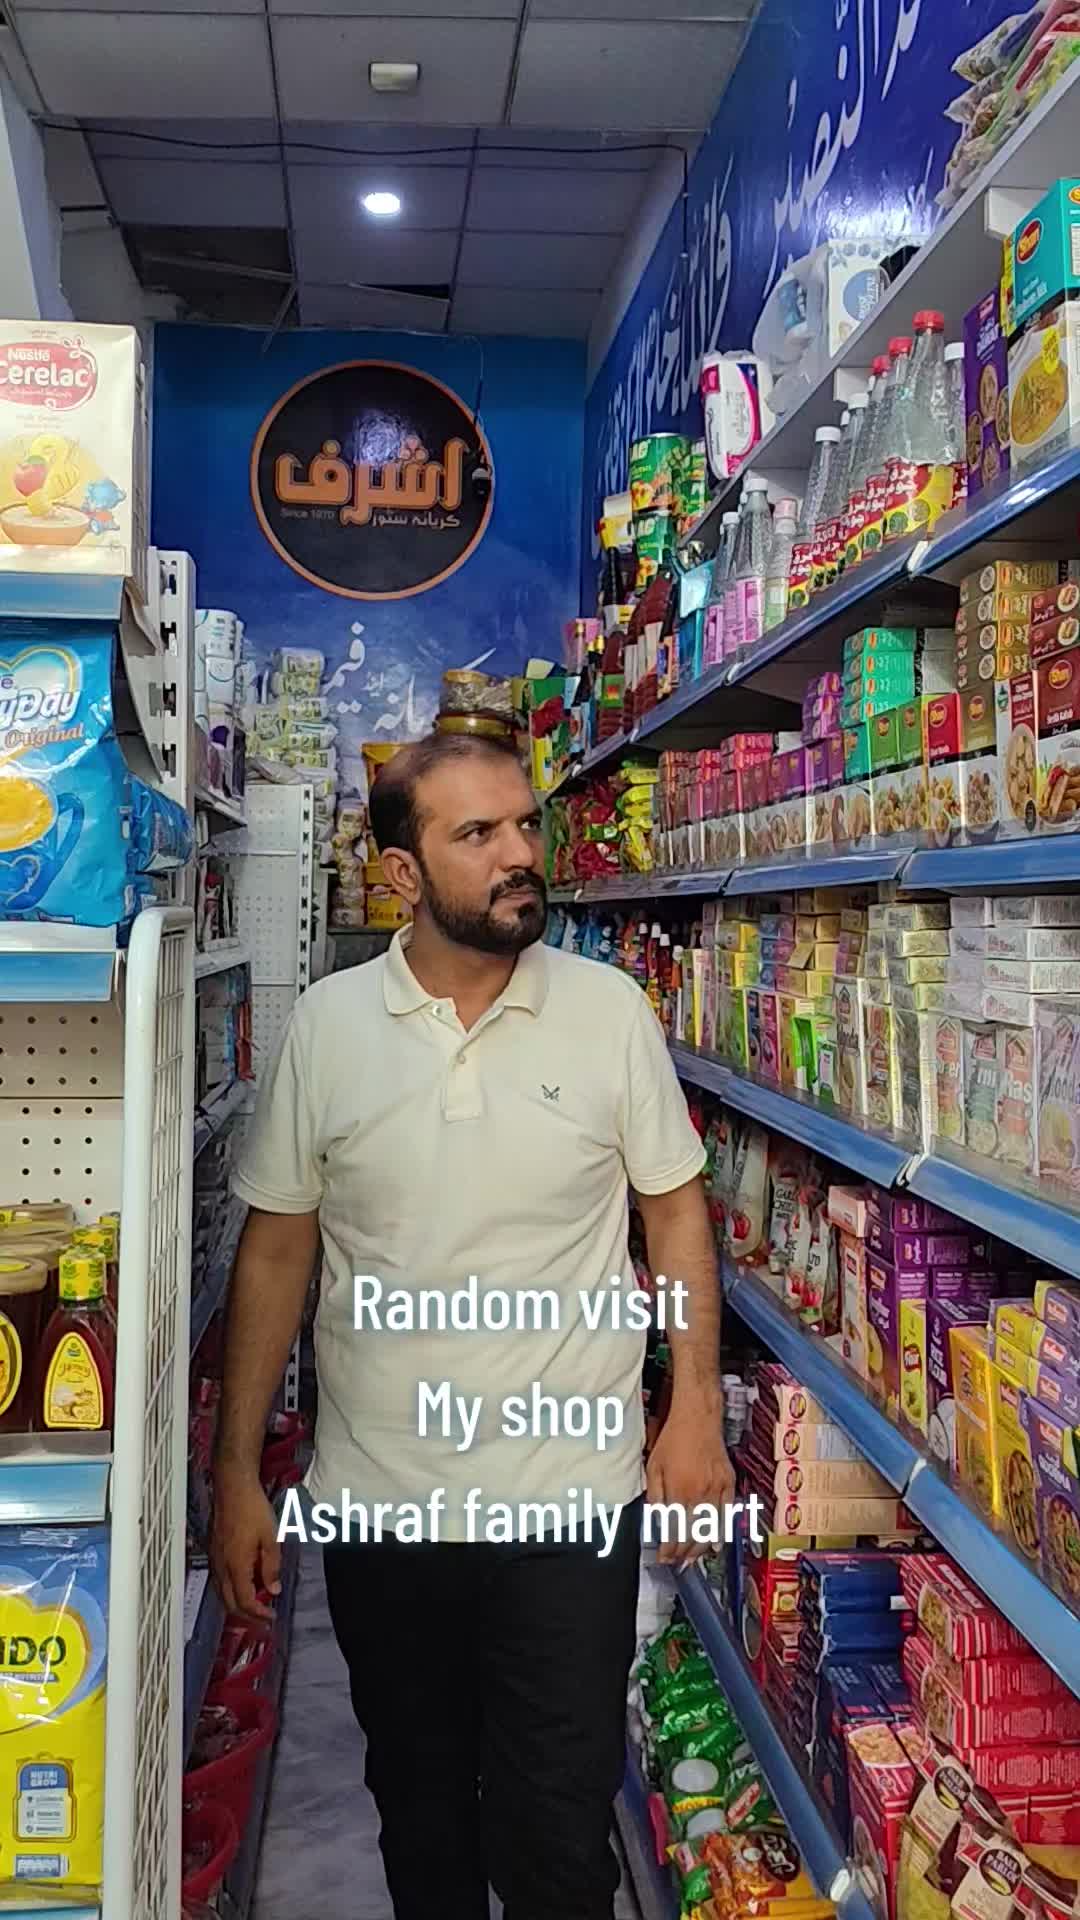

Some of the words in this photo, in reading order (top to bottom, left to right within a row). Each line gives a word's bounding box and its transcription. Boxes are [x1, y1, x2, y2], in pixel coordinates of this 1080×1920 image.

[0, 687, 81, 731] yDay
[5, 722, 84, 748] Original
[0, 1635, 67, 1667] IDO
